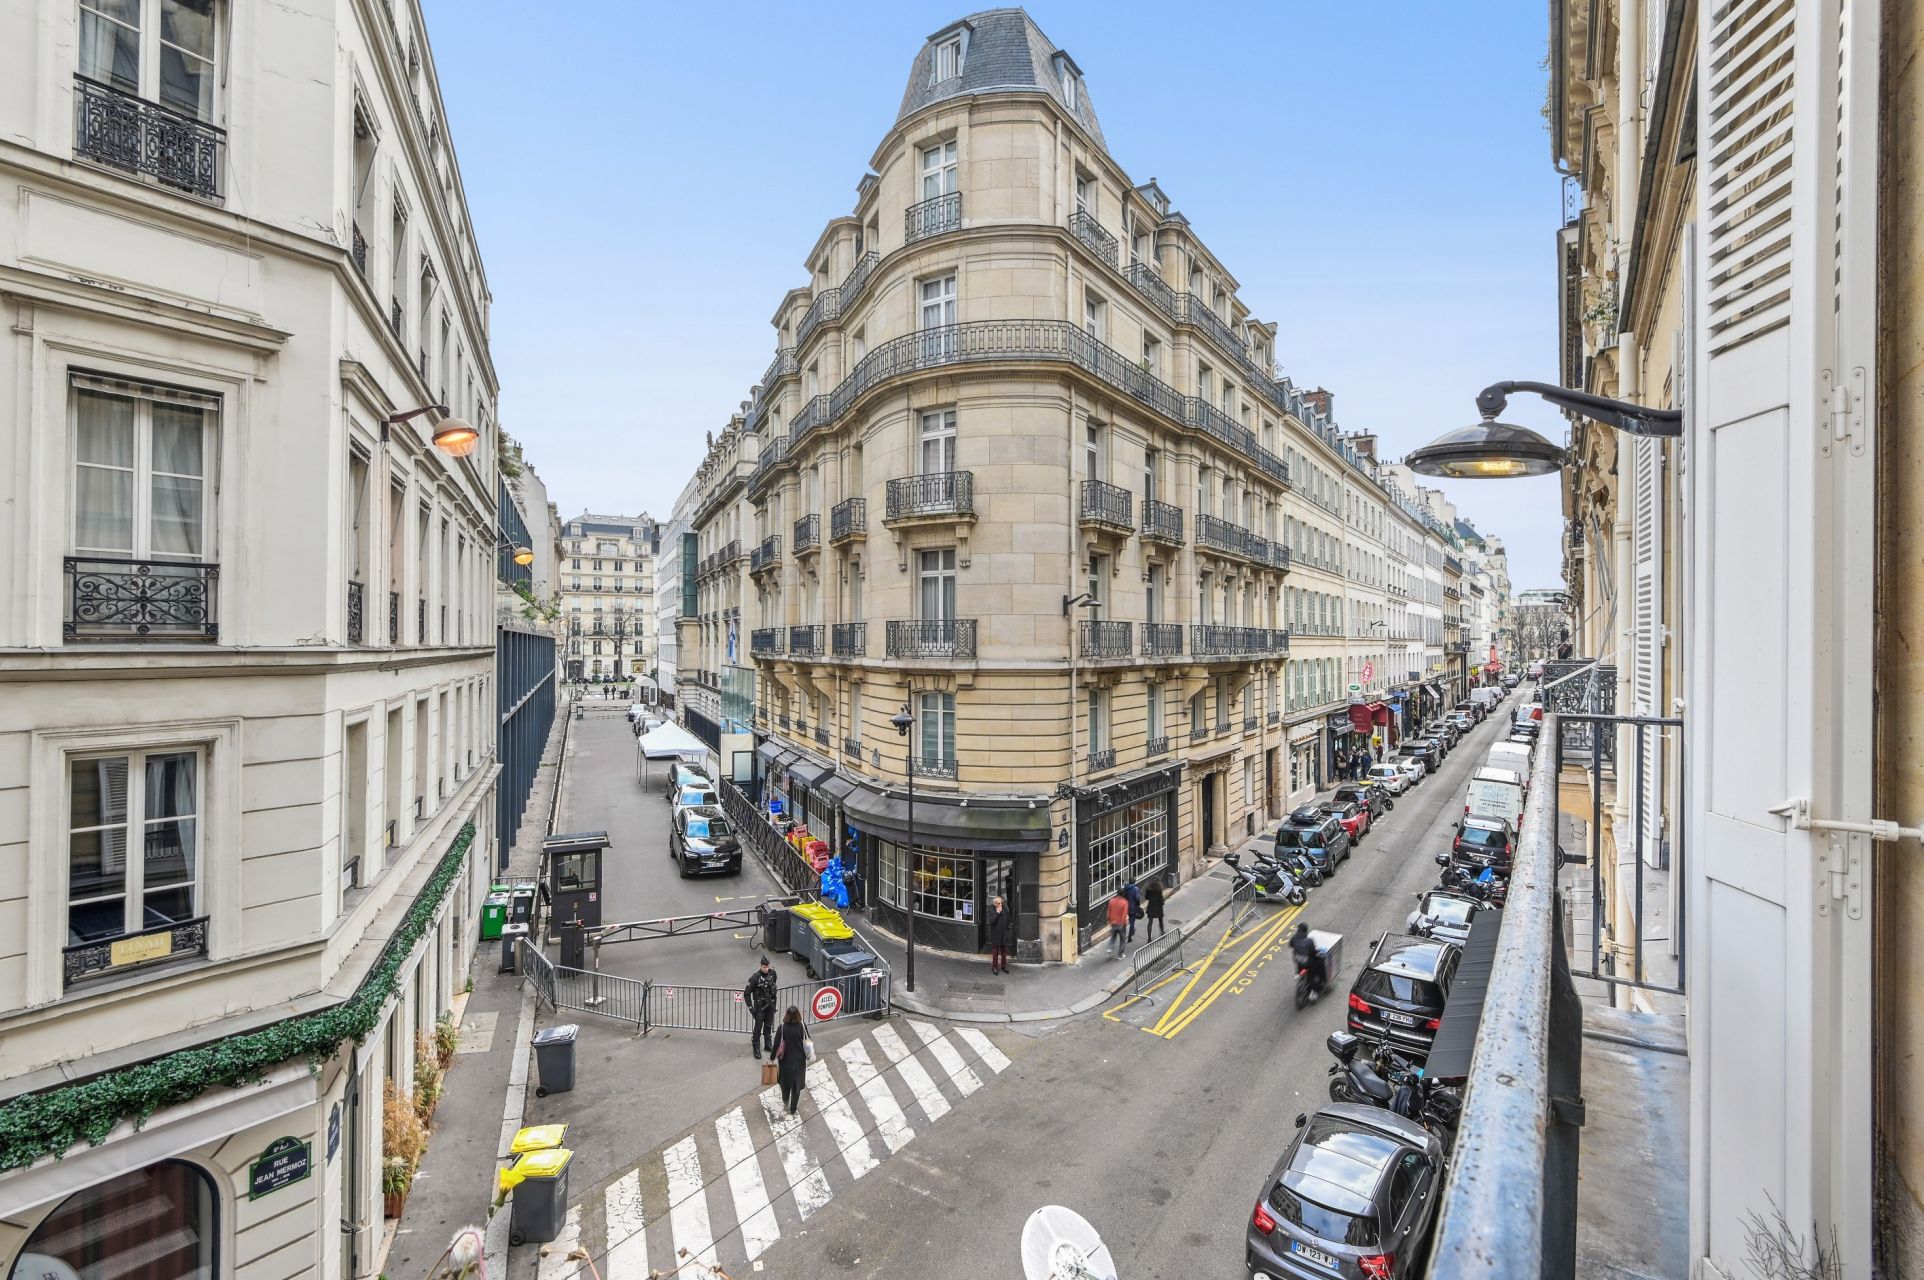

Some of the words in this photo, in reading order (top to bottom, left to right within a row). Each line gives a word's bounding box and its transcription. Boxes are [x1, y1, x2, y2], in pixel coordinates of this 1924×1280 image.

[254, 1171, 275, 1185] JEAN
[276, 1158, 307, 1176] MERMOZ
[273, 1156, 289, 1168] RUE
